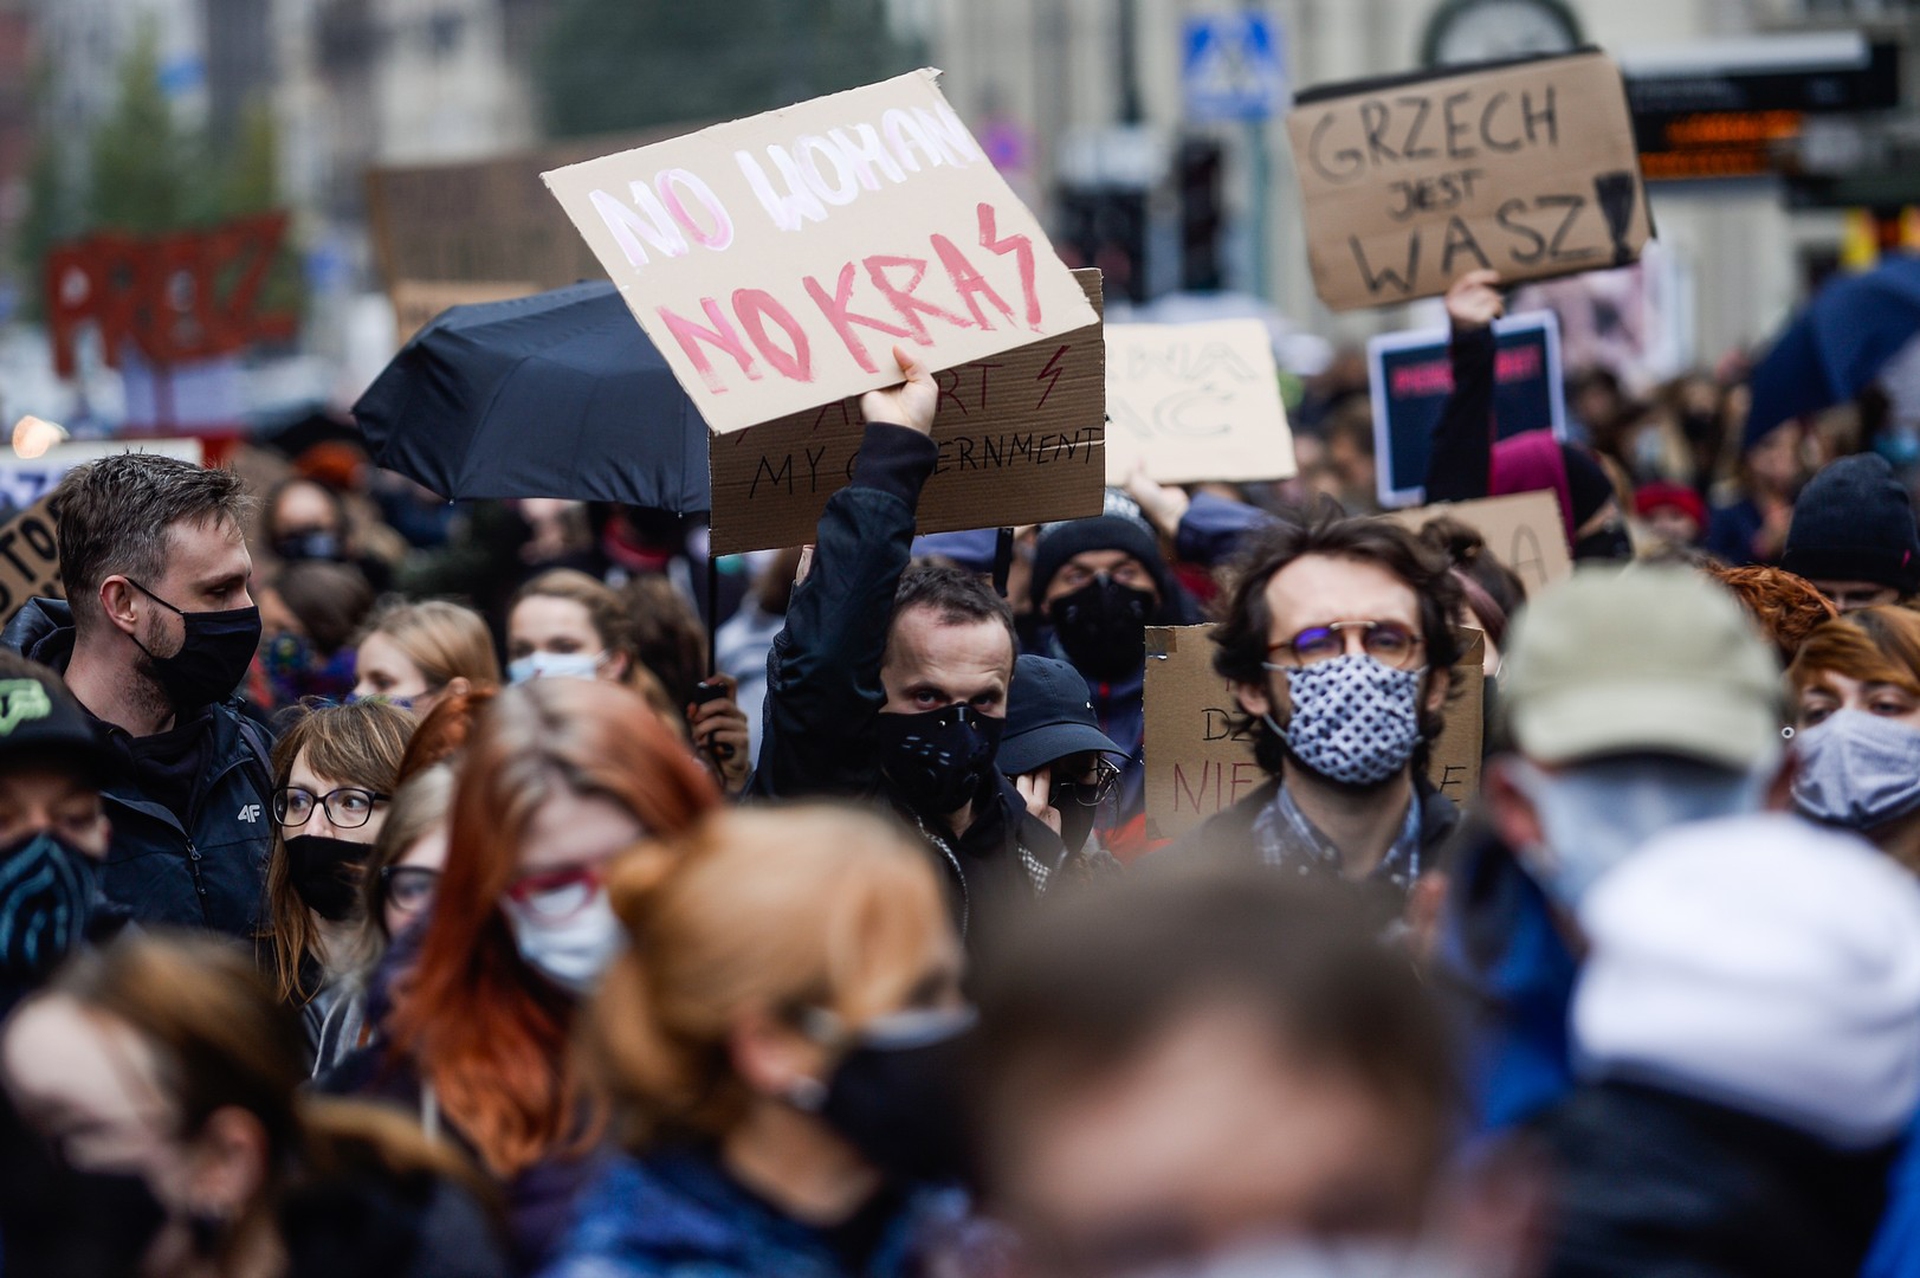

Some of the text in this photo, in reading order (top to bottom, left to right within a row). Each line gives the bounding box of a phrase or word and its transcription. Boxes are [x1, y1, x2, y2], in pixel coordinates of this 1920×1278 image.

[1307, 82, 1559, 186] GRZECH
[588, 167, 735, 268] NO
[1385, 166, 1486, 222] JEST
[656, 287, 817, 395] NO
[749, 426, 1101, 499] MY ERNMENT
